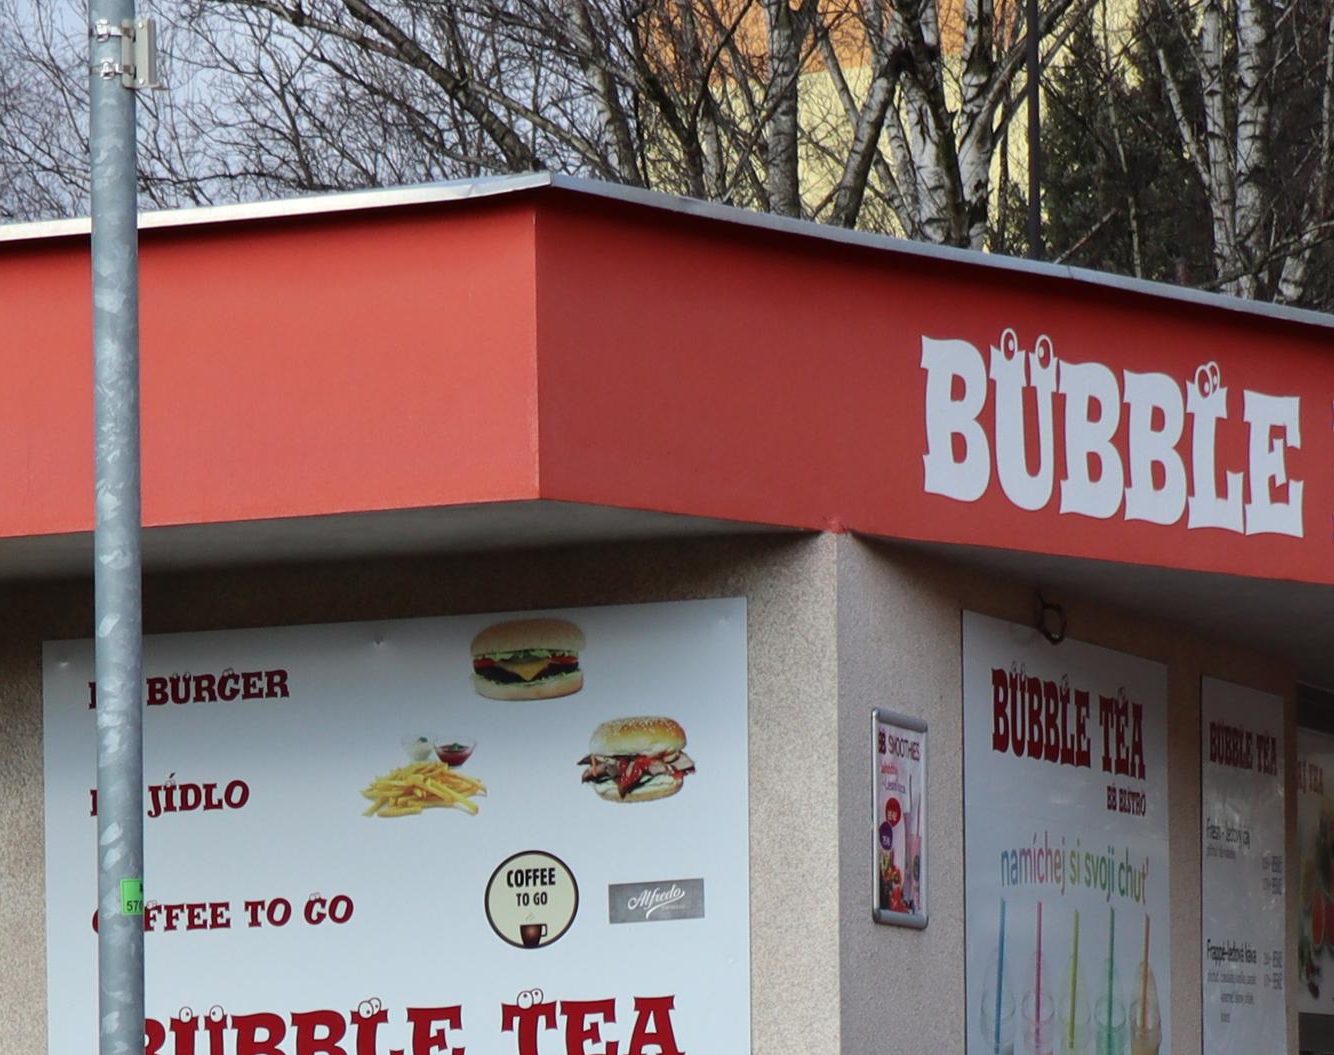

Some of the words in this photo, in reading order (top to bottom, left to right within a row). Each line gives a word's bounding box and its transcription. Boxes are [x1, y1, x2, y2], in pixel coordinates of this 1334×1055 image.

[920, 328, 1304, 538] BUBBLE
[146, 669, 290, 706] BURGER
[992, 663, 1091, 768] BUBBLE
[1099, 688, 1146, 780] TEA
[1209, 721, 1253, 770] BUBBLE
[1256, 731, 1277, 776] TEA
[147, 773, 249, 818] JÍDLO
[1119, 787, 1146, 816] BISTRO
[506, 868, 556, 887] COFFEE
[1001, 830, 1065, 895] namíchej
[1070, 839, 1081, 885] si
[1084, 845, 1115, 902] svoji
[1118, 848, 1149, 904] chuť
[92, 901, 231, 935] FFEE
[244, 898, 292, 927] TO
[304, 895, 354, 925] GO
[516, 893, 530, 906] TO
[533, 892, 548, 905] GO
[627, 884, 685, 919] Alfredo
